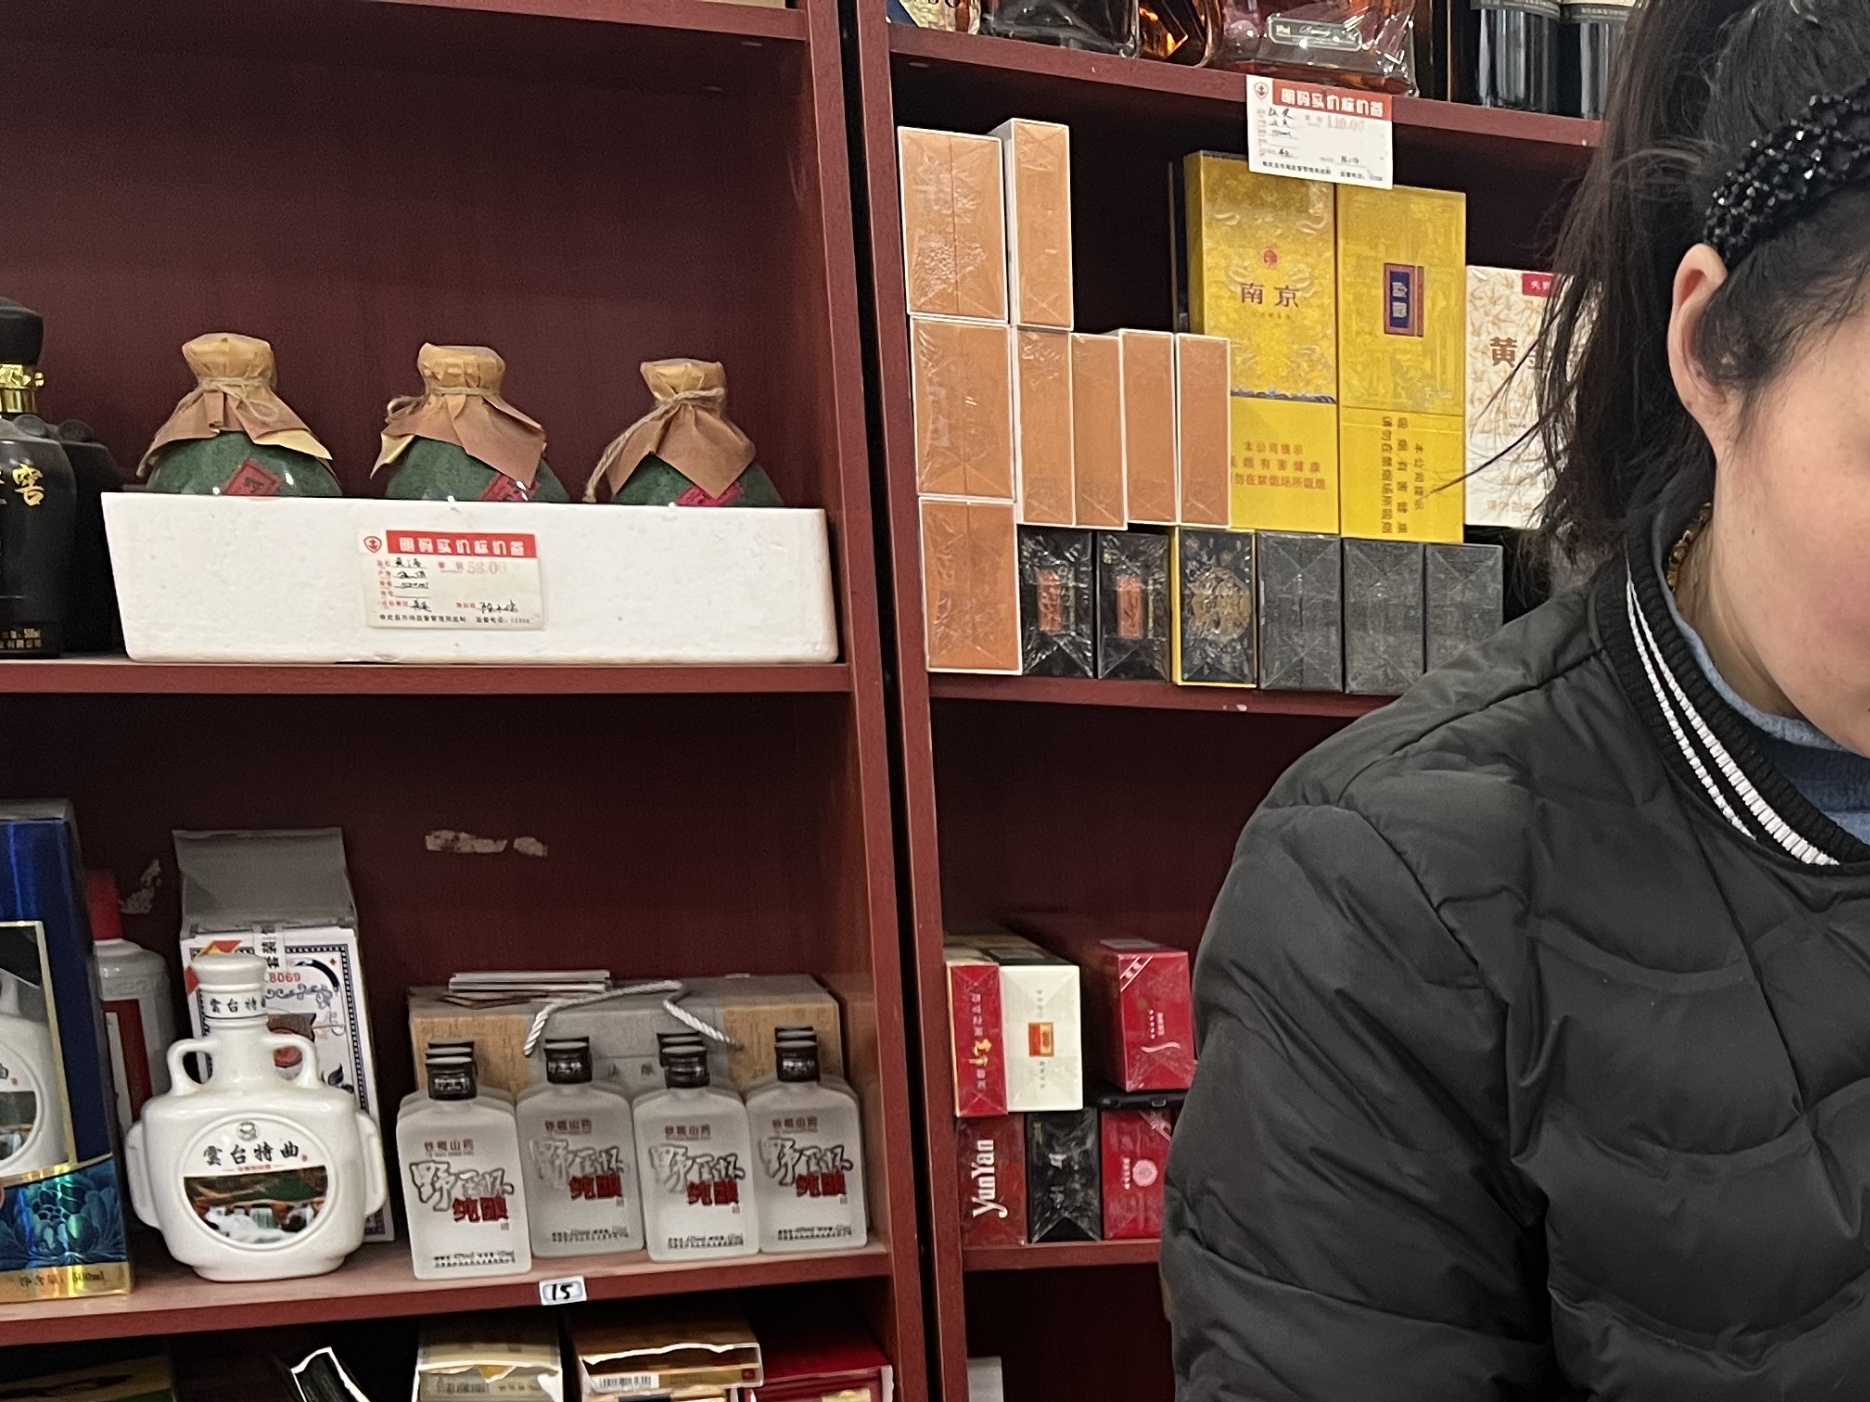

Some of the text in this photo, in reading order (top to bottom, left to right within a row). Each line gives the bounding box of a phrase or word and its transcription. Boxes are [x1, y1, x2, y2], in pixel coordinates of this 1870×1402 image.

[1240, 281, 1300, 308] 南京
[1230, 472, 1327, 491] 勿在禁烟场所吸烟
[399, 537, 525, 556] 明码实价标价签
[203, 1139, 300, 1167] 雲台特曲
[971, 1138, 1009, 1219] YunYan
[551, 1283, 574, 1300] 15
